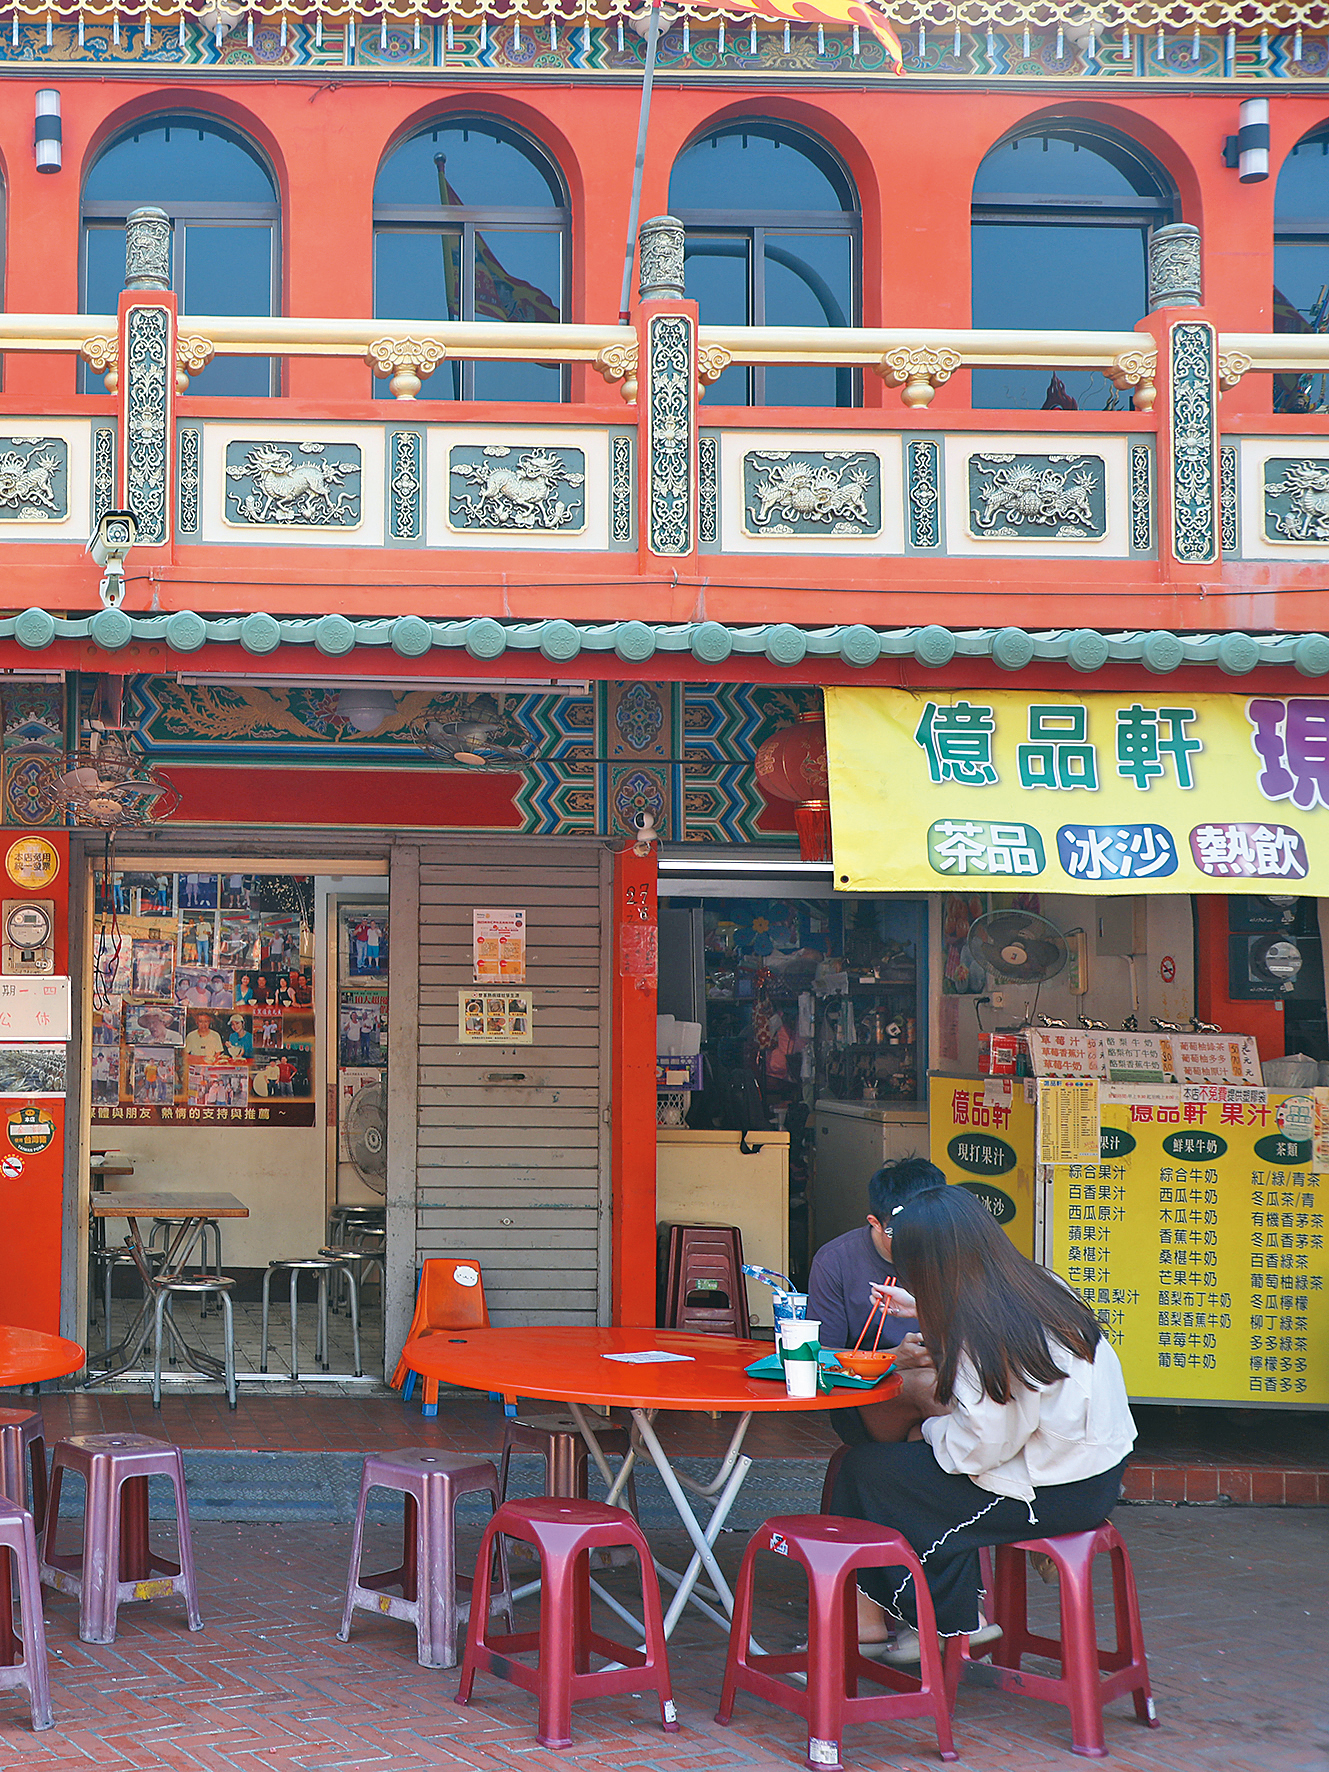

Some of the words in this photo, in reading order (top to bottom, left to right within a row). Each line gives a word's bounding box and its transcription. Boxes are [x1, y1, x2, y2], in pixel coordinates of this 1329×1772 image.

[914, 701, 1203, 791] 億品軒
[934, 820, 1039, 874] 茶品
[1064, 826, 1171, 878] 冰沙
[1196, 824, 1308, 878] 熱飲
[15, 853, 51, 861] 本店免用
[1042, 1035, 1080, 1046] 草莓汁
[161, 1107, 271, 1120] 熱情的支持與推薦
[957, 1142, 1005, 1167] 現打果汁
[1172, 1138, 1218, 1154] 鮮果牛奶
[1276, 1142, 1298, 1157] 茶類
[1068, 1165, 1126, 1180] 綜合果汁
[1160, 1168, 1219, 1184] 綜合牛奶
[1251, 1170, 1321, 1188] 紅/綠/青茶
[1068, 1185, 1126, 1201] 百香果汁
[1160, 1188, 1218, 1205] 西瓜牛奶
[1251, 1191, 1315, 1209] 冬瓜茶/青
[1068, 1205, 1126, 1221] 西瓜原汁
[1160, 1208, 1218, 1225] 木瓜牛奶
[1251, 1211, 1324, 1229] 有機香茅茶
[1068, 1225, 1111, 1241] 蘋果汁
[1159, 1229, 1218, 1246] 香蕉牛奶
[1251, 1232, 1324, 1249] 冬瓜香茅茶
[1068, 1246, 1111, 1262] 桑椹汁
[1159, 1249, 1218, 1266] 桑椹牛奶
[1251, 1252, 1309, 1269] 百香綠茶
[1068, 1266, 1111, 1283] 芒果汁
[1159, 1270, 1217, 1287] 芒果牛奶
[1250, 1273, 1323, 1290] 葡萄柚綠茶
[1074, 1287, 1140, 1304] 果鳳梨汁
[1158, 1290, 1232, 1309] 酪梨布丁牛奶
[1250, 1293, 1309, 1311] 冬瓜檸檬
[1092, 1308, 1125, 1325] 萄汁
[1158, 1311, 1232, 1329] 酪梨香蕉牛奶
[1250, 1314, 1309, 1331] 柳丁綠茶
[1158, 1332, 1217, 1349] 草莓牛奶
[1250, 1335, 1308, 1352] 多多綠茶
[1158, 1352, 1217, 1369] 葡萄牛奶
[1249, 1355, 1308, 1373] 檸檬多多
[1249, 1376, 1308, 1393] 百香多多
